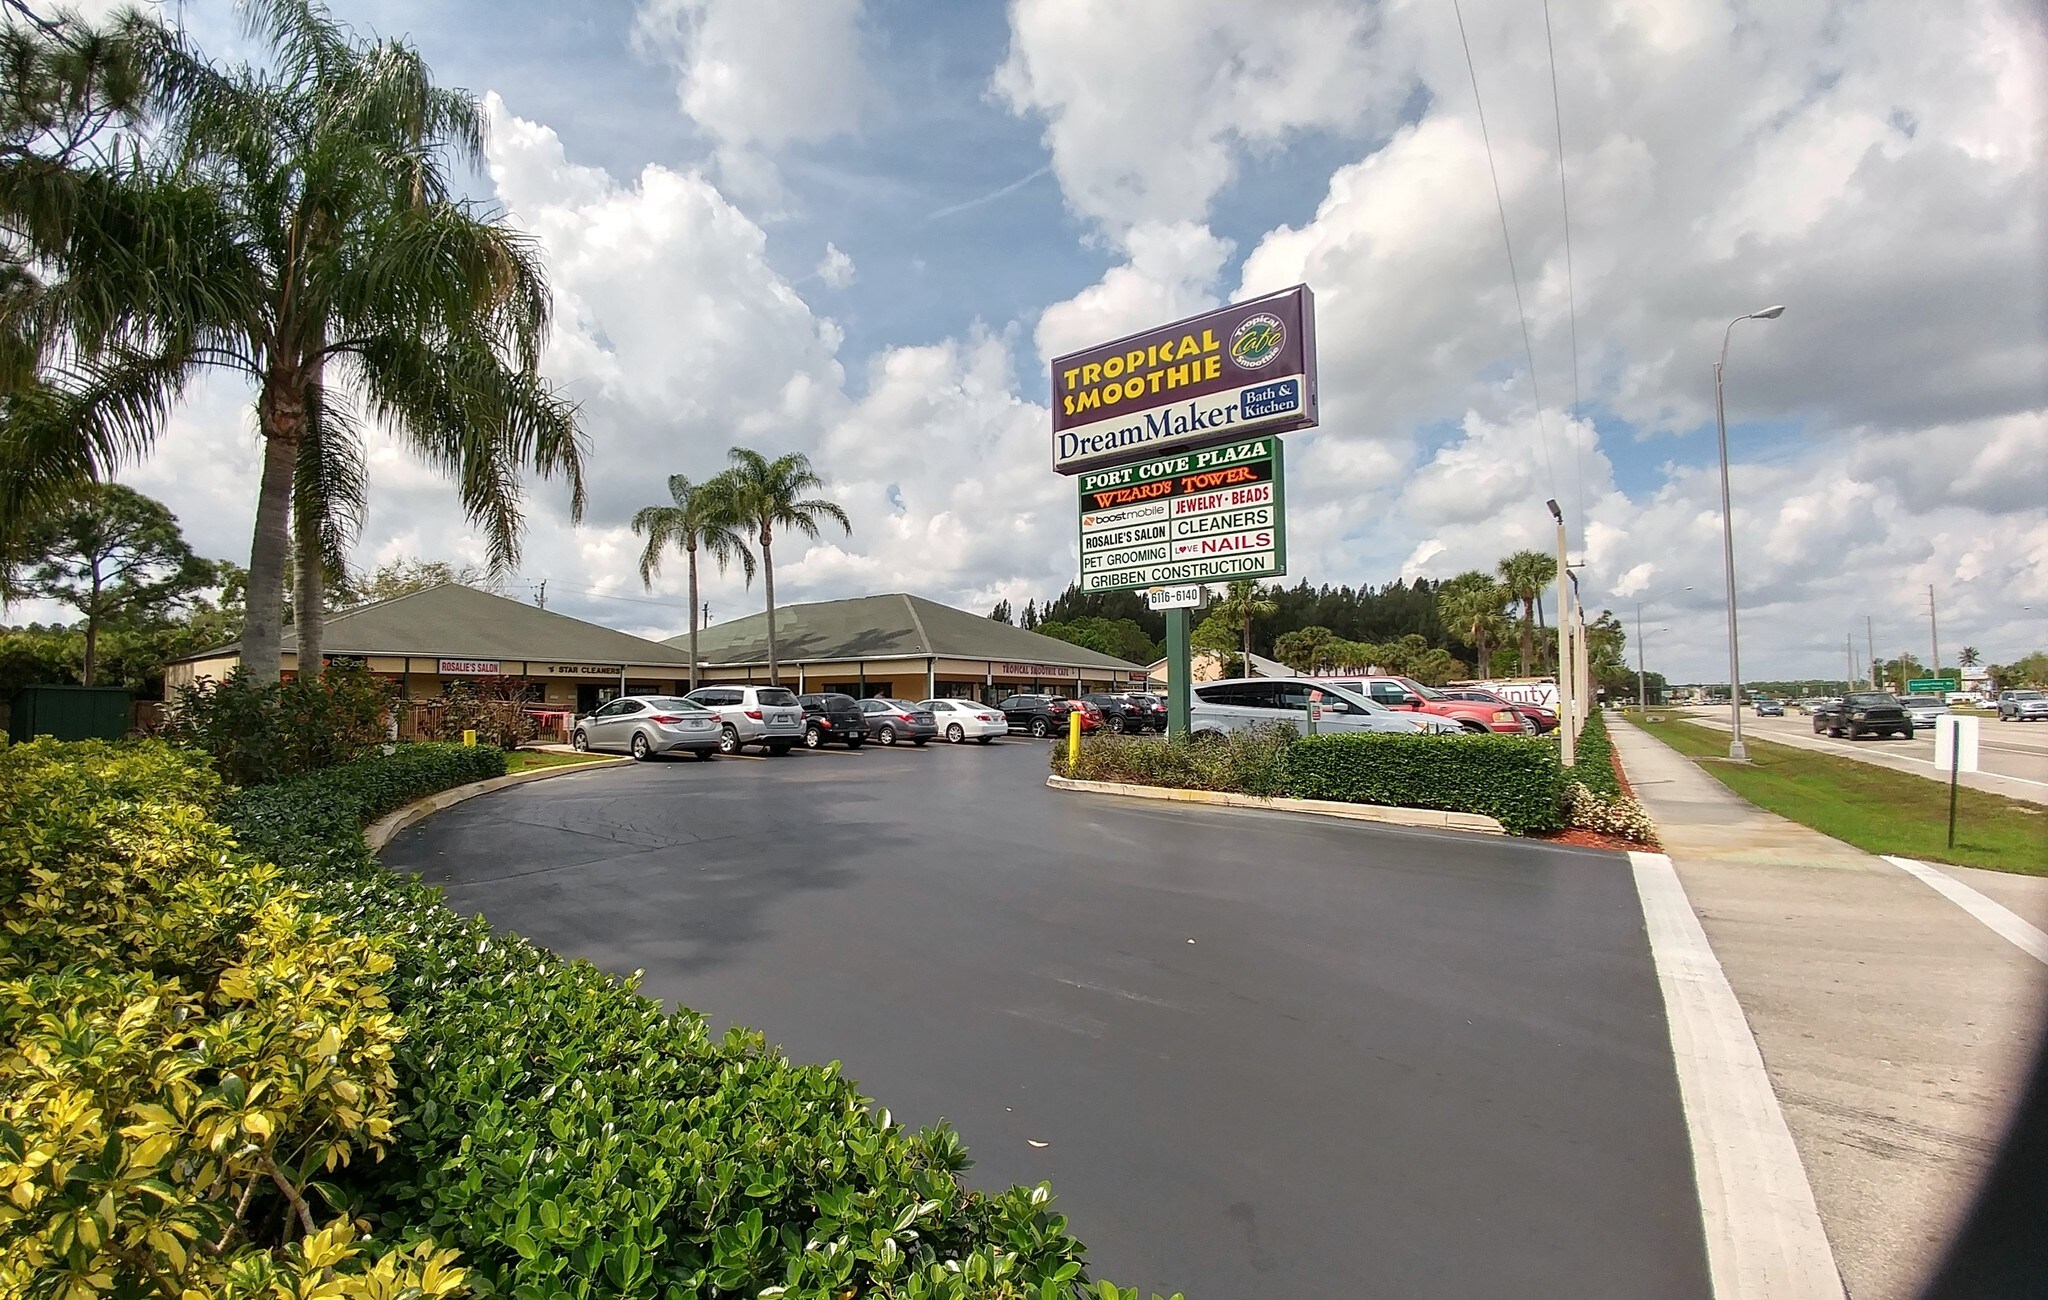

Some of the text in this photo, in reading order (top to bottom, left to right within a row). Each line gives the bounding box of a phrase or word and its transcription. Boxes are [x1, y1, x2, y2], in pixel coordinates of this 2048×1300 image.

[1235, 315, 1280, 337] Tropical
[1064, 329, 1220, 390] TROPICAL
[1236, 347, 1280, 368] Smoothie
[1064, 355, 1221, 416] SMOOTHIE
[1246, 384, 1293, 404] Bath &
[1244, 398, 1295, 417] Kitchen
[1059, 402, 1239, 460] DreamMaker
[1085, 442, 1267, 490] PORT COVE PLAZA
[1093, 466, 1258, 508] WIZARD'S TOWER
[1176, 486, 1269, 514] JEWELRY BEADS
[1178, 509, 1268, 535] CLEANERS
[1086, 526, 1166, 549] ROSALIE'S SALON
[1202, 532, 1271, 554] NAILS
[1084, 547, 1166, 568] PET GROOMING
[1091, 570, 1146, 588] GRIBBEN
[1151, 556, 1265, 580] CONSTRUCTION
[1151, 588, 1198, 604] 6116-6140
[441, 661, 498, 673] ROSALIE'S SALON
[558, 666, 579, 674] STAR
[1002, 664, 1029, 674] TROPICAL
[1495, 687, 1552, 706] finity
